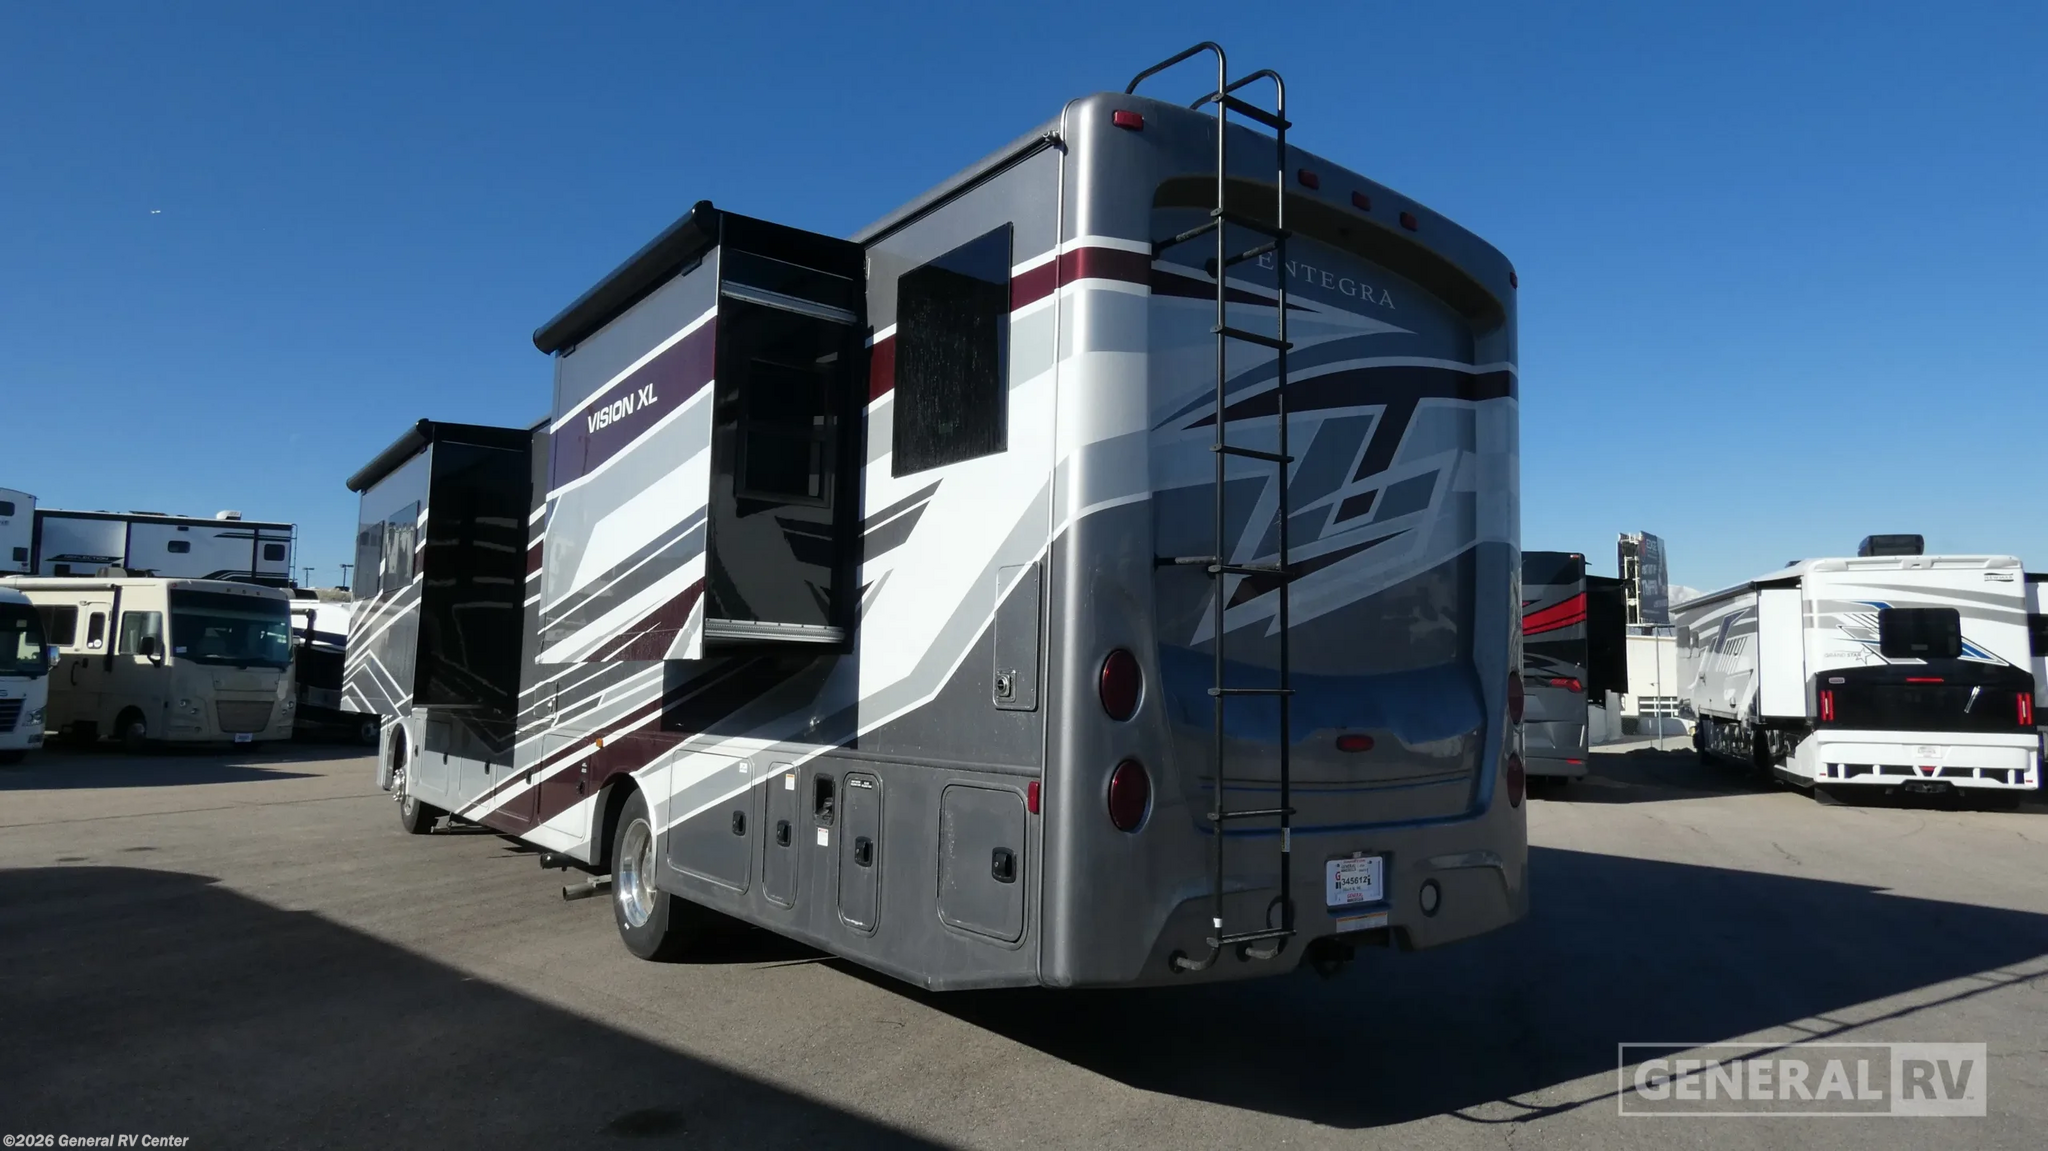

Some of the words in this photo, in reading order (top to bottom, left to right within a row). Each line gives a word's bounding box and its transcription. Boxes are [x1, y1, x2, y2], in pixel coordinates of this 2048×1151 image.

[1256, 251, 1396, 310] ENTEGRA
[587, 393, 635, 434] VISION
[636, 382, 658, 411] XL
[1341, 876, 1367, 885] 345612
